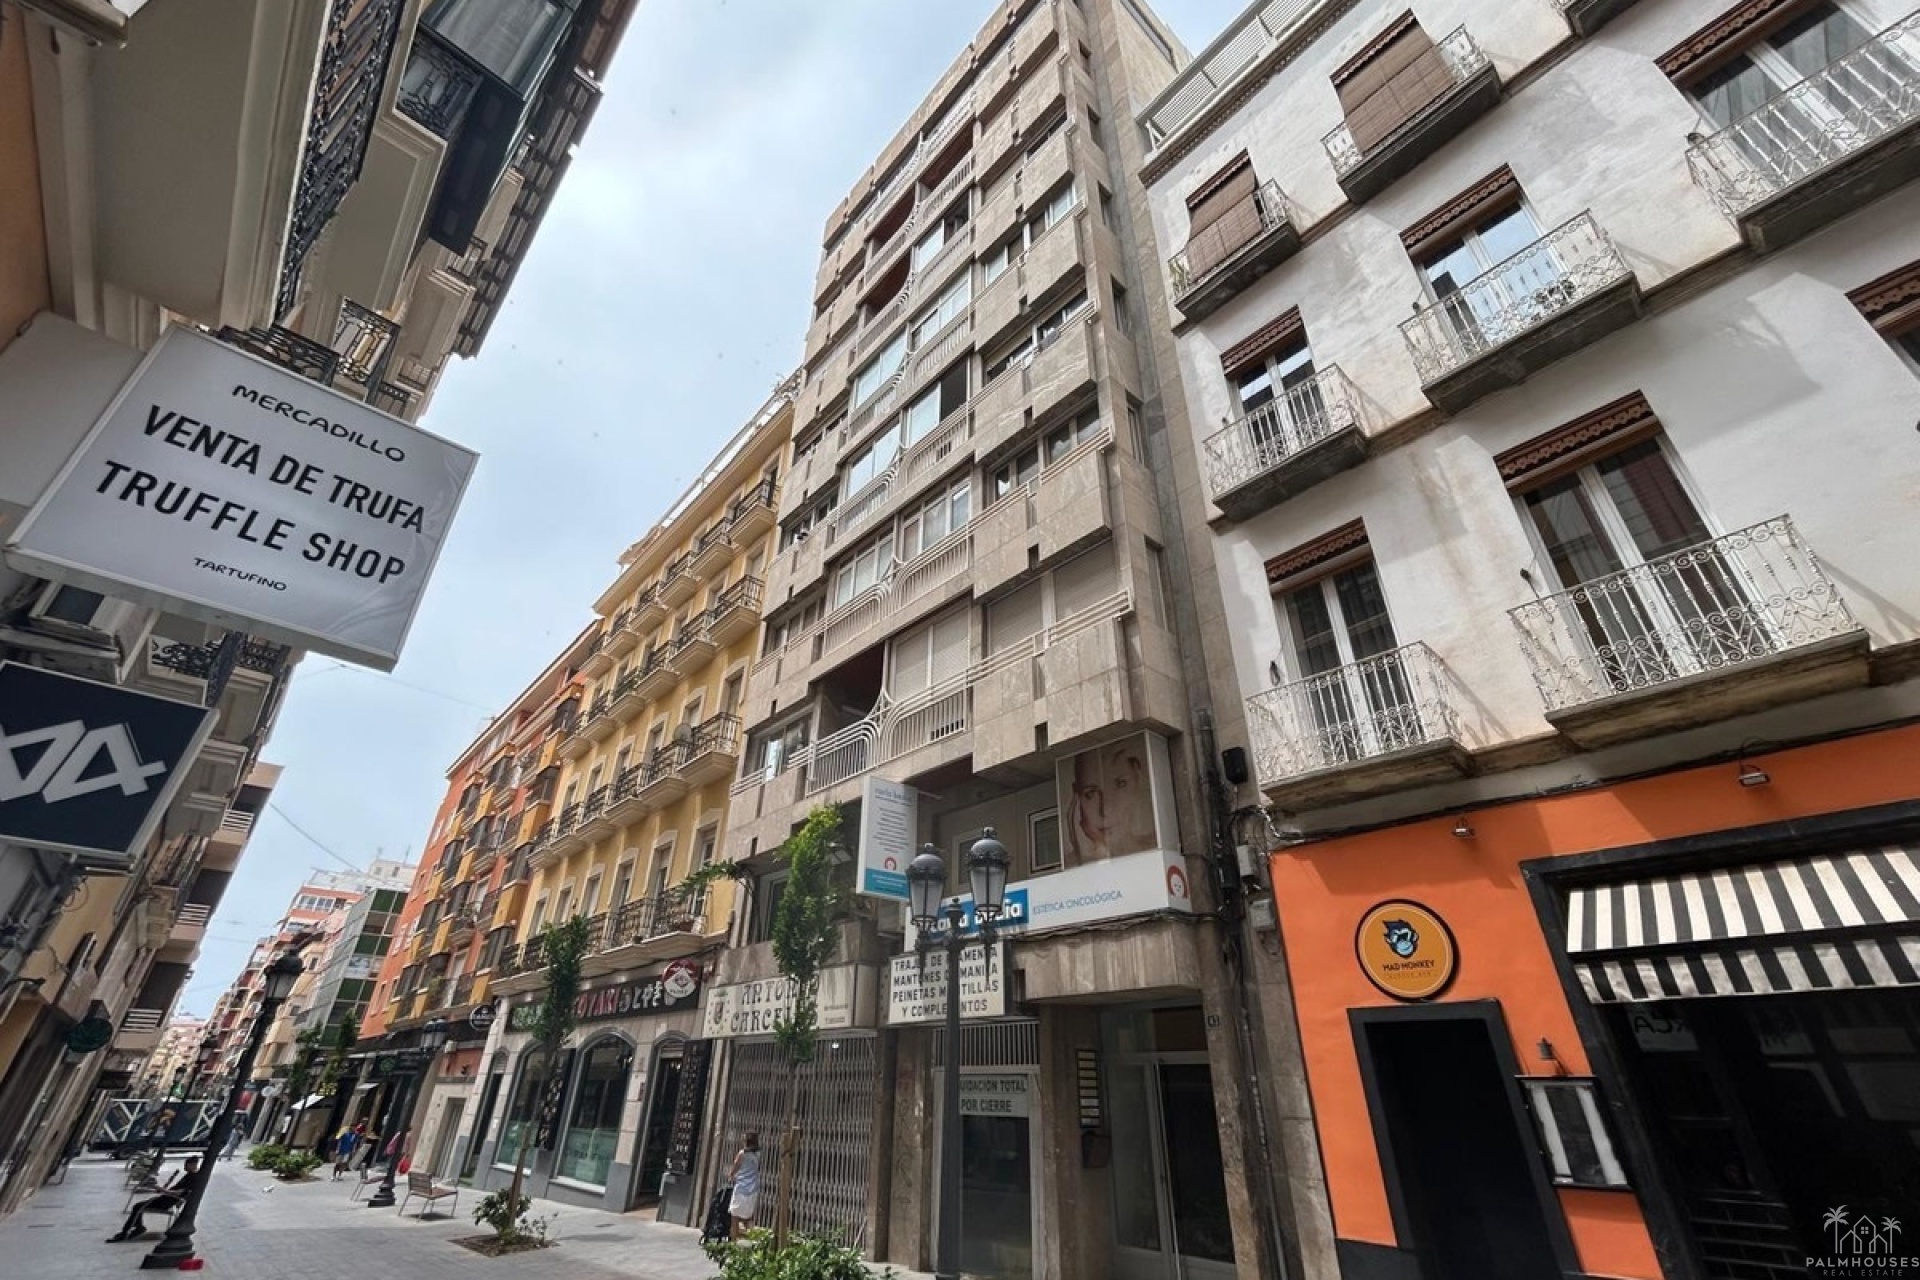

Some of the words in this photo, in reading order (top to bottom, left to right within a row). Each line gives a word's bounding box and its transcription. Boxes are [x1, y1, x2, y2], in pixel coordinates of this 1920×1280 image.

[232, 383, 405, 462] MERCADILLO
[143, 405, 260, 474] VENTA
[269, 453, 325, 497] DE
[319, 474, 426, 535] TRUFA
[95, 460, 296, 551] TRUFFLE
[302, 531, 405, 586] SHOP
[193, 556, 287, 591] TARTUFINO
[895, 957, 922, 972] TRAJE
[1382, 962, 1400, 971] MAD
[1401, 959, 1434, 970] MONKEY
[893, 970, 941, 987] MANTNES
[959, 962, 998, 979] MANIA
[939, 980, 999, 998] MTILLAS
[901, 1006, 908, 1018] Y
[911, 999, 988, 1017] COMPLENTOS
[1000, 1079, 1027, 1092] TOTAL
[961, 1098, 978, 1112] POR
[980, 1098, 1012, 1113] CIERRE
